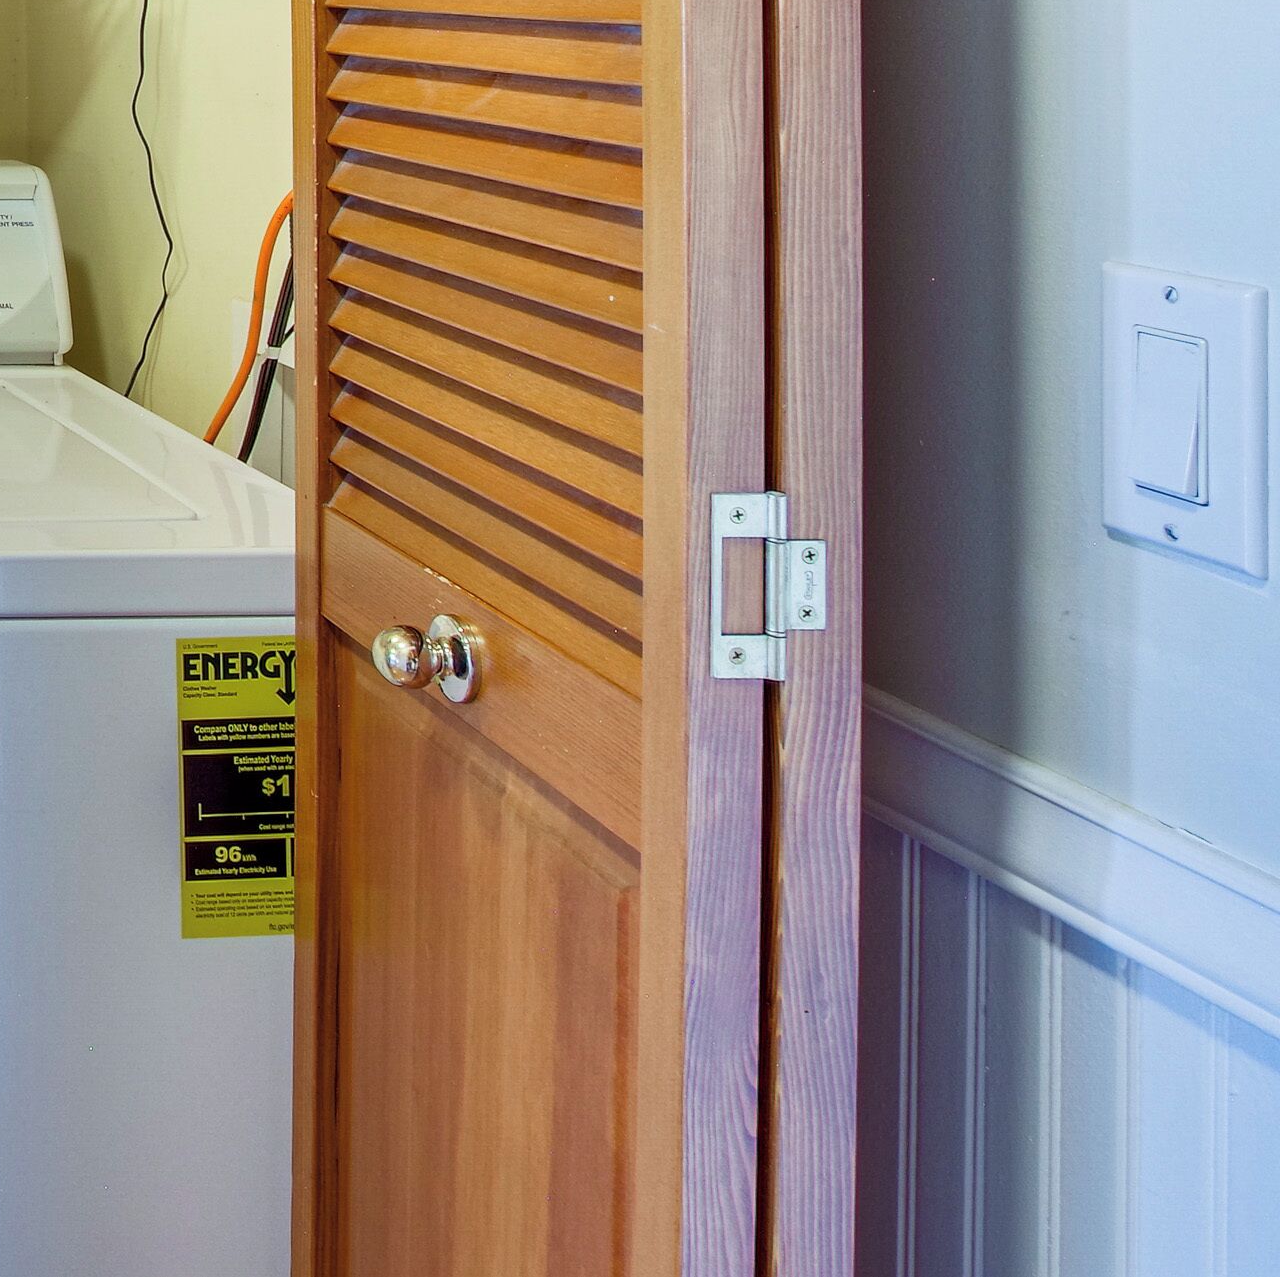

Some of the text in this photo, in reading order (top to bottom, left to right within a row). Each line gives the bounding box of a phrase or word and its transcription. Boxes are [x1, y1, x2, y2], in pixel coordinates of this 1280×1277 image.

[193, 725, 227, 734] Compare
[228, 723, 248, 733] ONLY
[258, 723, 278, 731] other
[229, 733, 246, 741] yellow
[233, 755, 293, 764] Estimated Yearly
[262, 774, 290, 796] $1
[215, 846, 242, 863] 96
[195, 868, 221, 876] Estimated
[222, 867, 238, 875] Yearly
